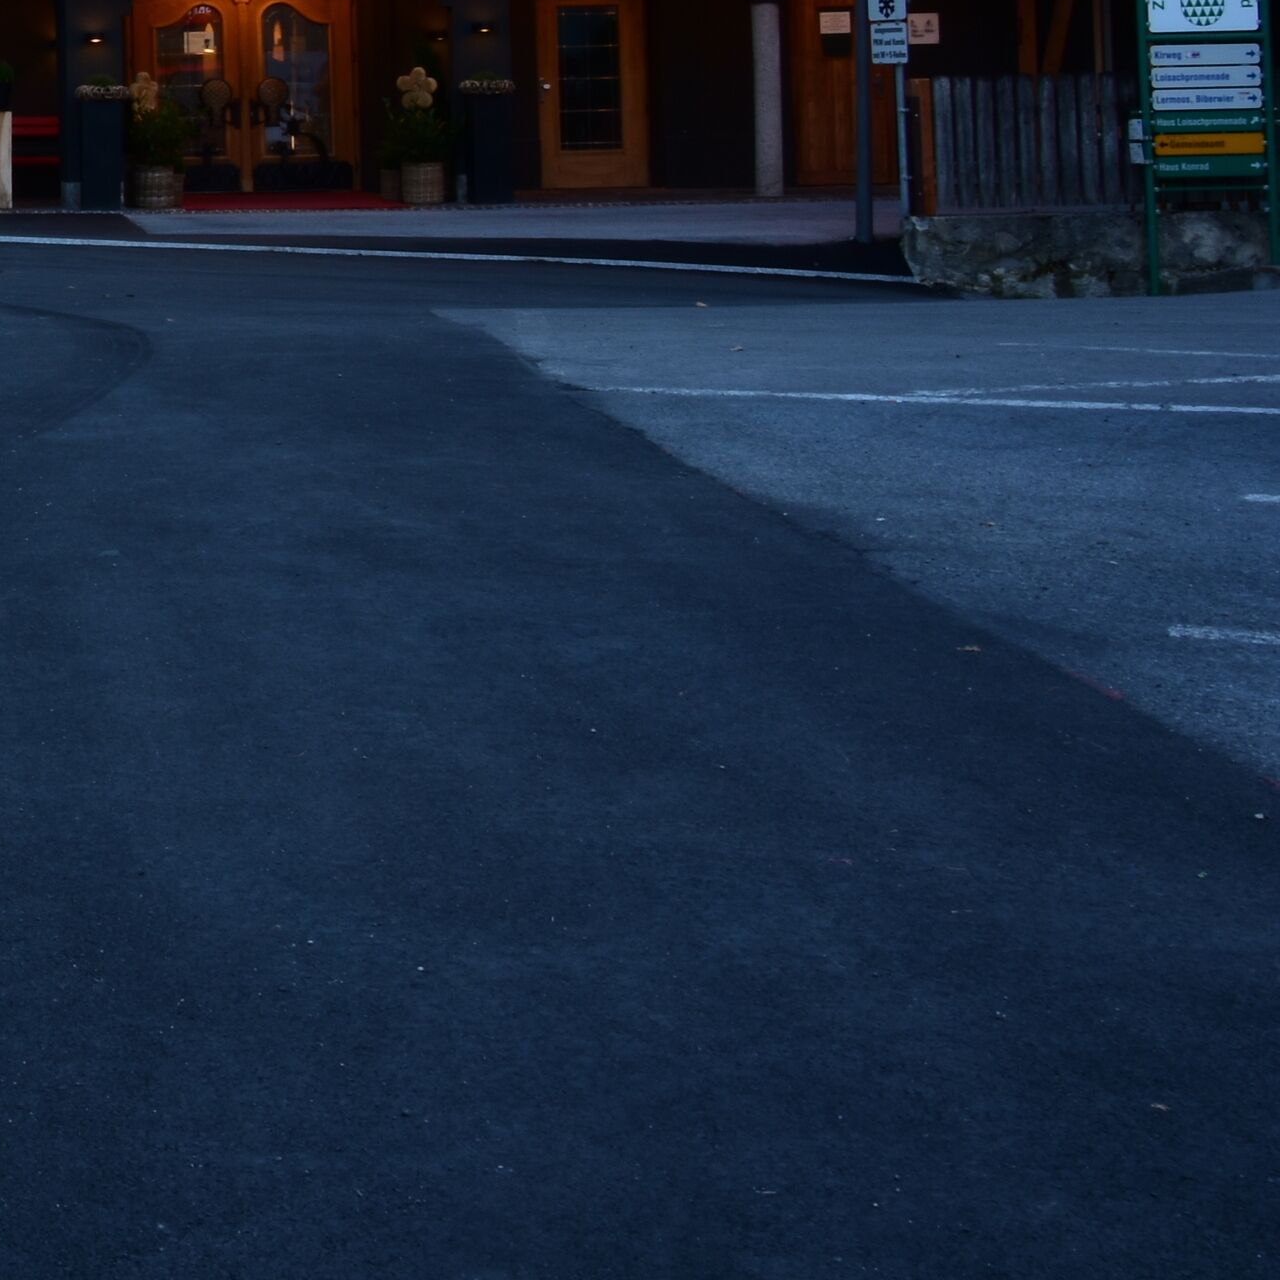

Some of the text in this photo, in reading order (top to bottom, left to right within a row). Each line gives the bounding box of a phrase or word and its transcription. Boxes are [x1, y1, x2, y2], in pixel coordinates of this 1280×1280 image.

[1154, 51, 1182, 61] Kirweg
[1154, 72, 1230, 83] Loisachpromenade
[1196, 94, 1234, 104] Biberwier
[1156, 116, 1248, 127] Haus Loisachpromenade
[1159, 161, 1210, 171] Haus Konrad
